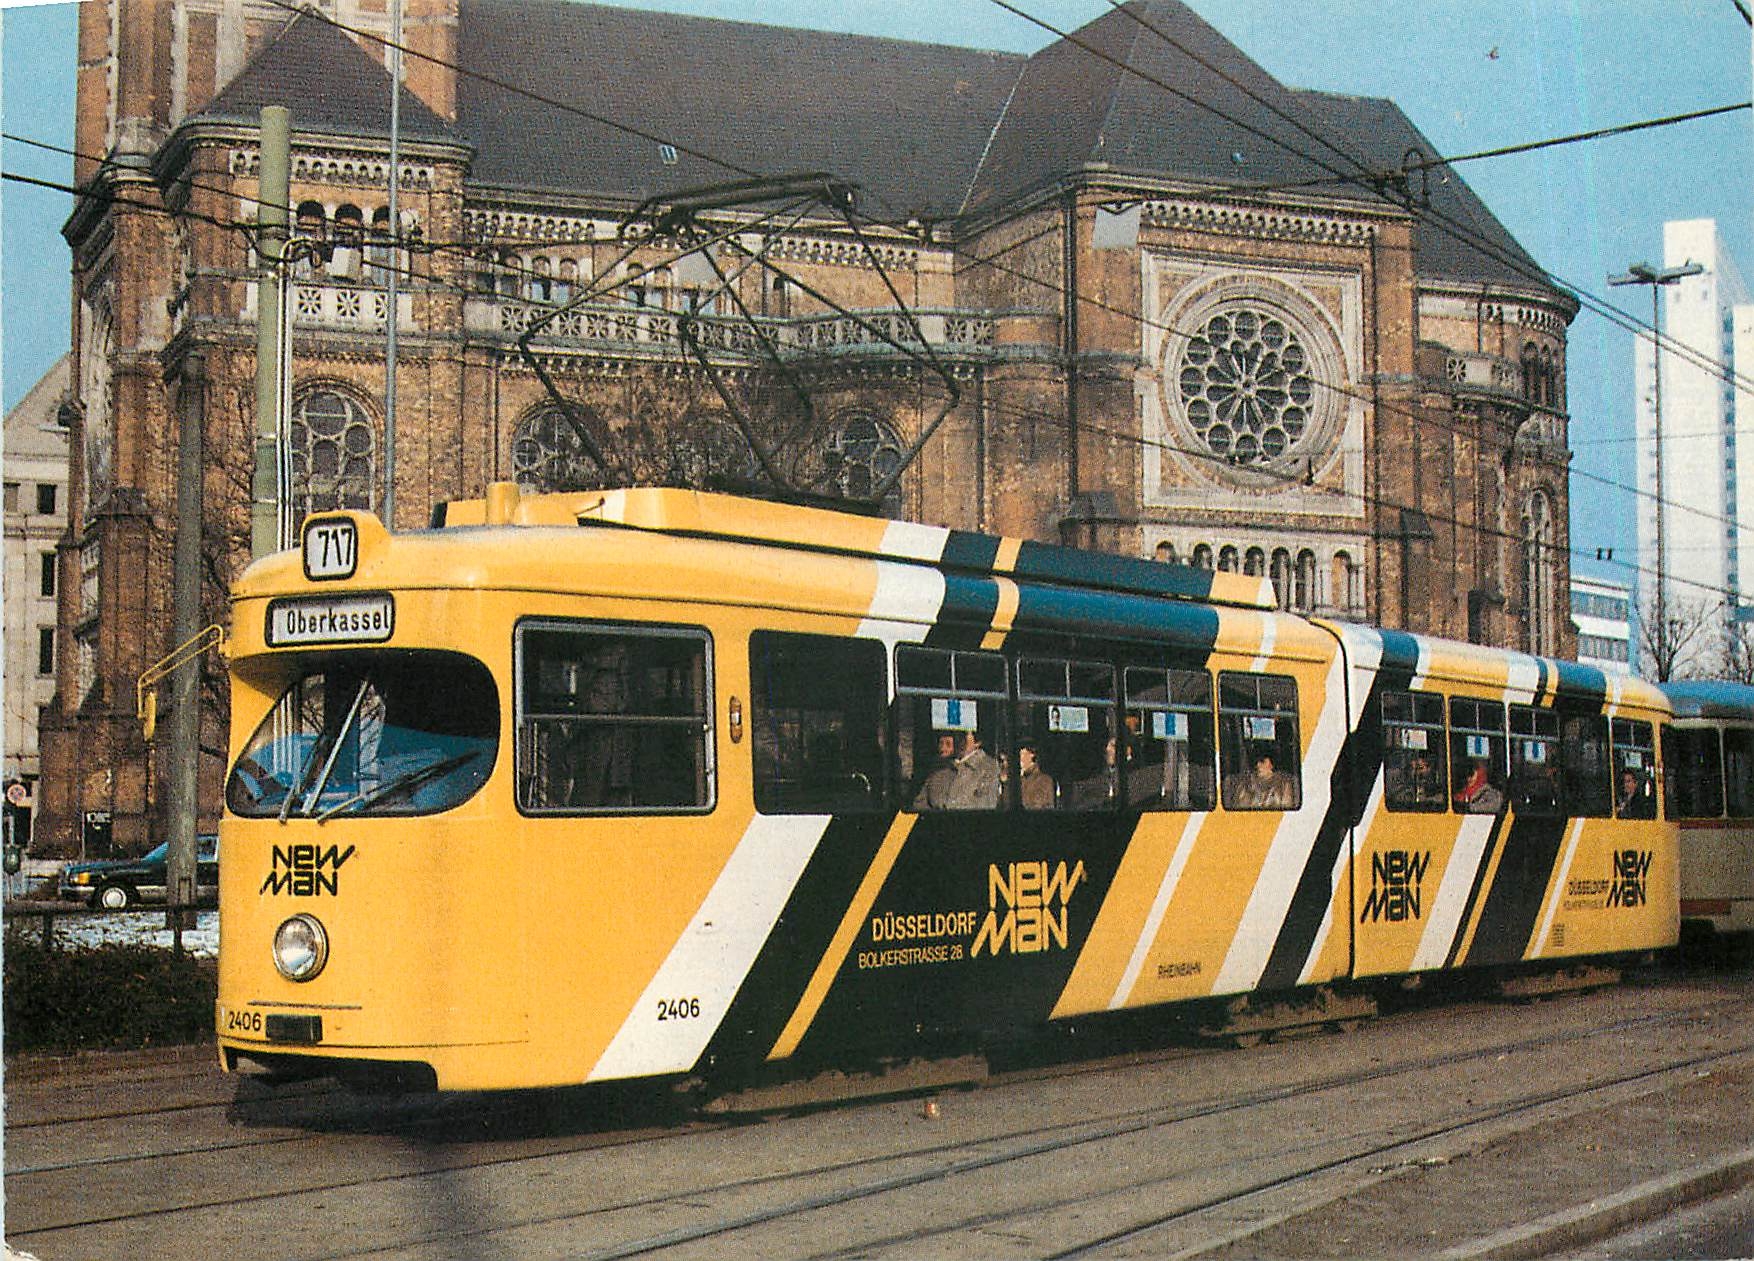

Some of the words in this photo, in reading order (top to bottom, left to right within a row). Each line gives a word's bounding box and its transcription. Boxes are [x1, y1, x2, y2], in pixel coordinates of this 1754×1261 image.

[318, 528, 352, 567] 717
[287, 604, 389, 635] Oberkassel
[872, 912, 977, 942] DÜSSELDORF
[858, 945, 949, 969] BOLKERSTRASSE
[228, 1011, 262, 1031] 2406
[657, 998, 700, 1021] 2406
